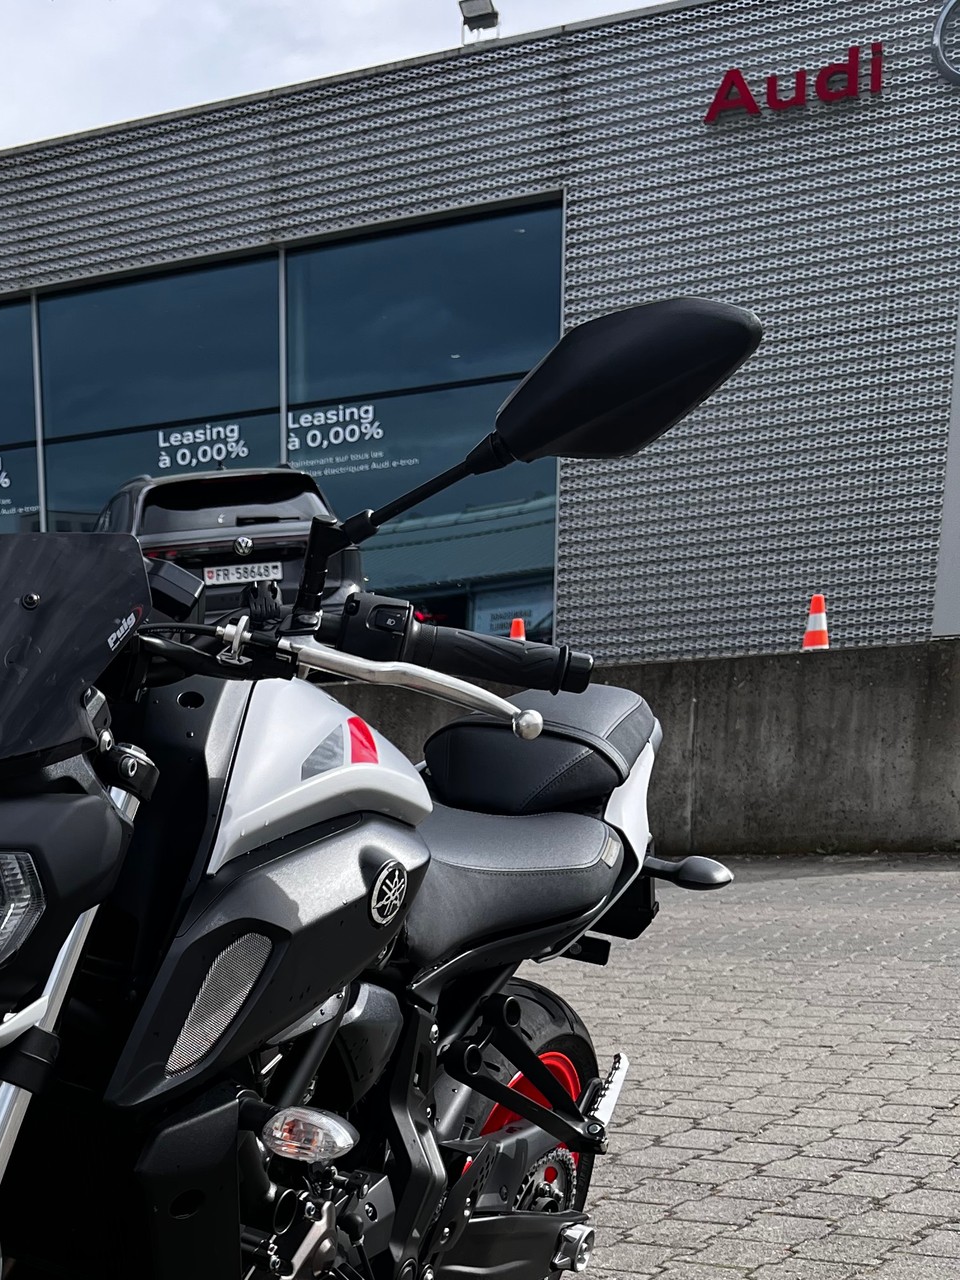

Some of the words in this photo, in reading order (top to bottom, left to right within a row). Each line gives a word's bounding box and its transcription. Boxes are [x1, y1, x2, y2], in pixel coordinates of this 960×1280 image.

[704, 41, 883, 125] Audi
[287, 404, 375, 429] Leasing
[158, 424, 239, 447] Leasing
[287, 433, 300, 450] à
[306, 421, 384, 449] 0,00%
[158, 451, 171, 468] à
[176, 440, 249, 467] 0,00%
